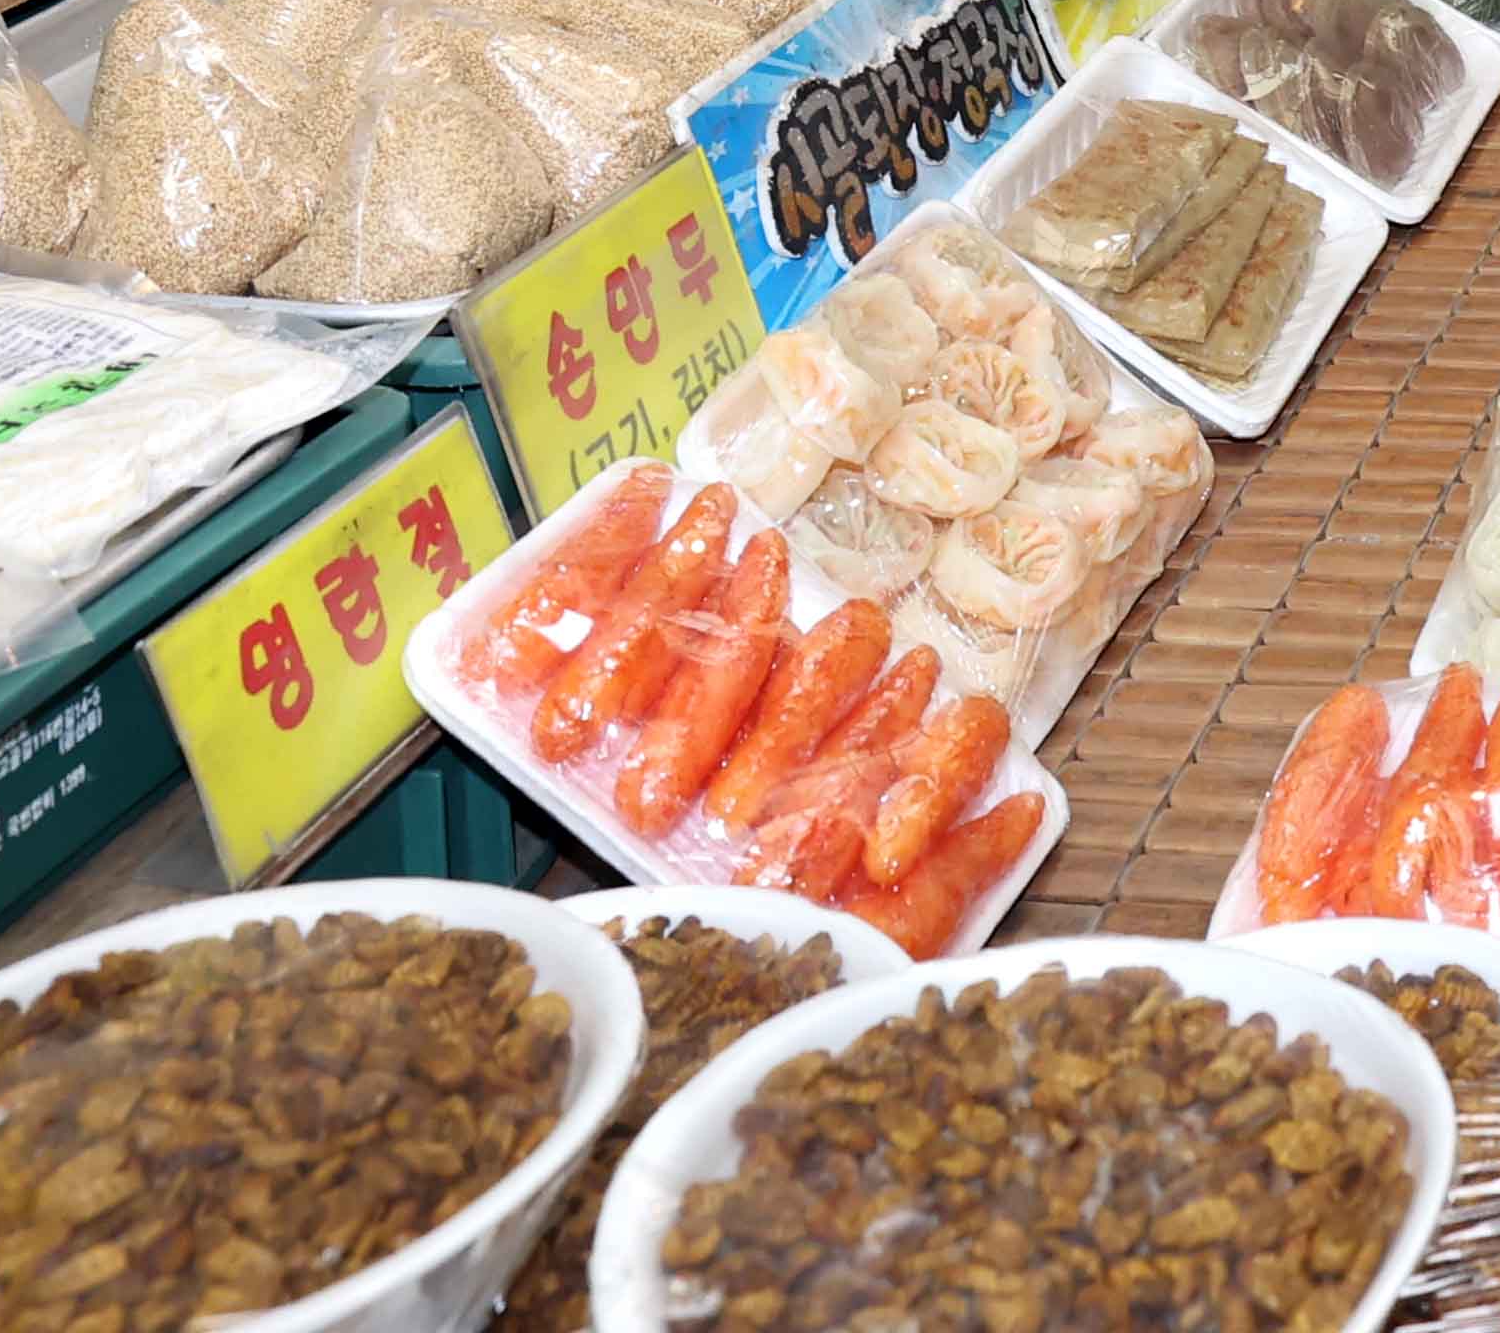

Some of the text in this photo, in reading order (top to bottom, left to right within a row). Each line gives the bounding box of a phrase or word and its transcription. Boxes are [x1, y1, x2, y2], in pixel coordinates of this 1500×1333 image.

[545, 210, 720, 423] 손만두
[670, 318, 750, 421] 김치)
[237, 483, 472, 731] 명란젓
